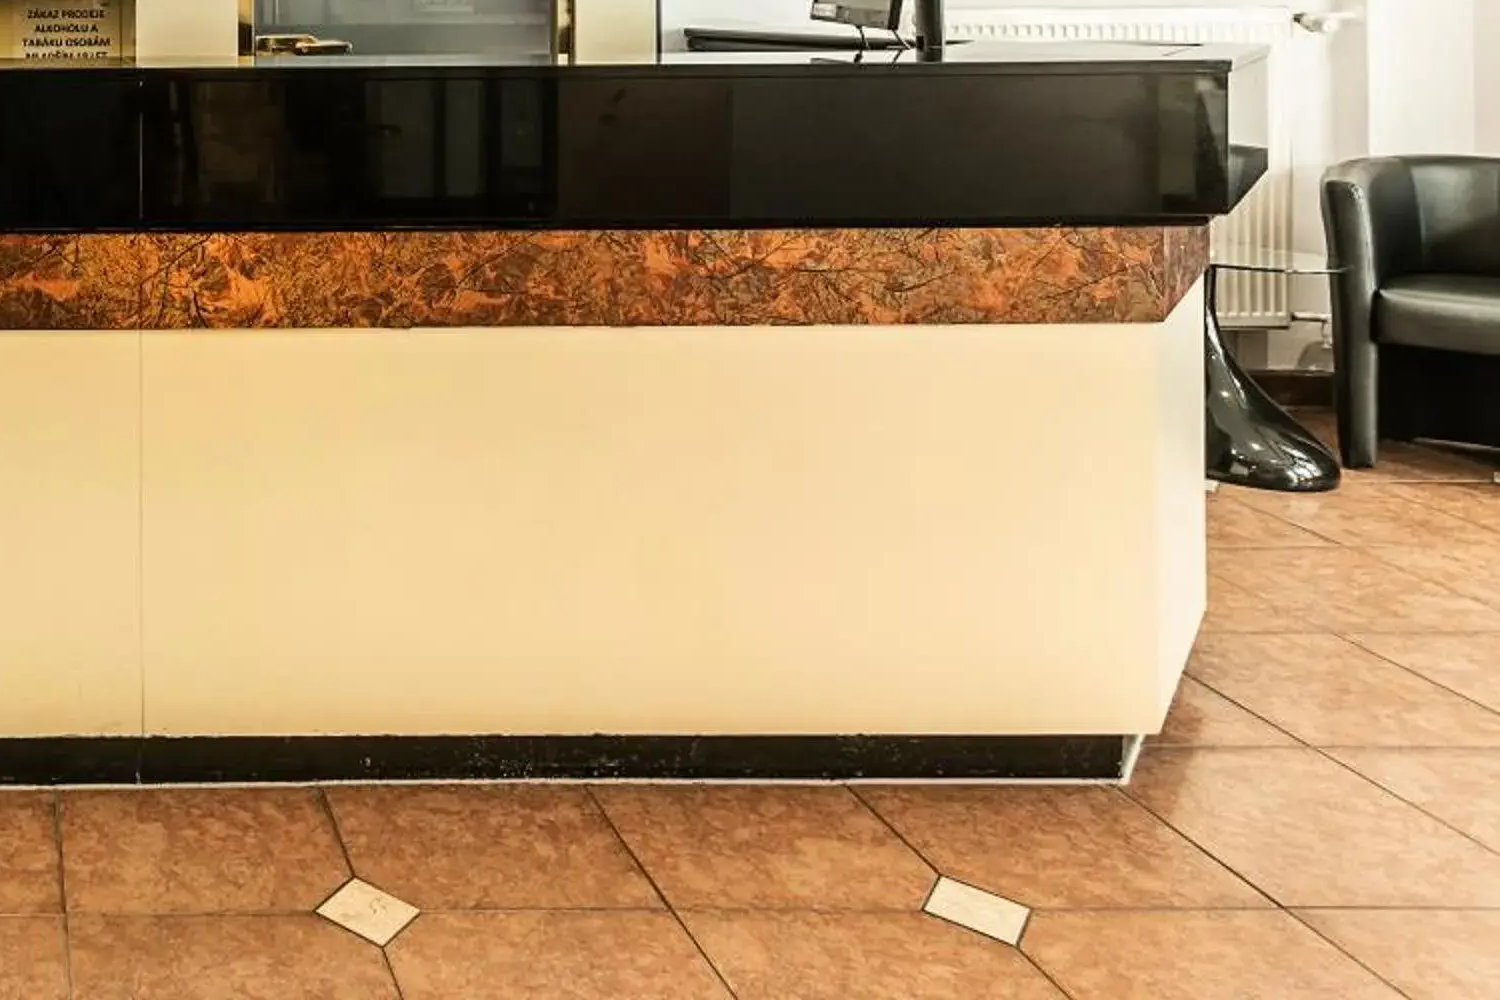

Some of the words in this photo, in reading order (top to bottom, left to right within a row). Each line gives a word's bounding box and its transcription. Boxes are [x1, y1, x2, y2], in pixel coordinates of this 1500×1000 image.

[27, 8, 59, 19] ZÁKAZ
[35, 24, 89, 33] ALKOHOLU
[90, 24, 98, 33] A
[23, 37, 63, 47] TABÁKU
[65, 36, 111, 47] OSOBÁM
